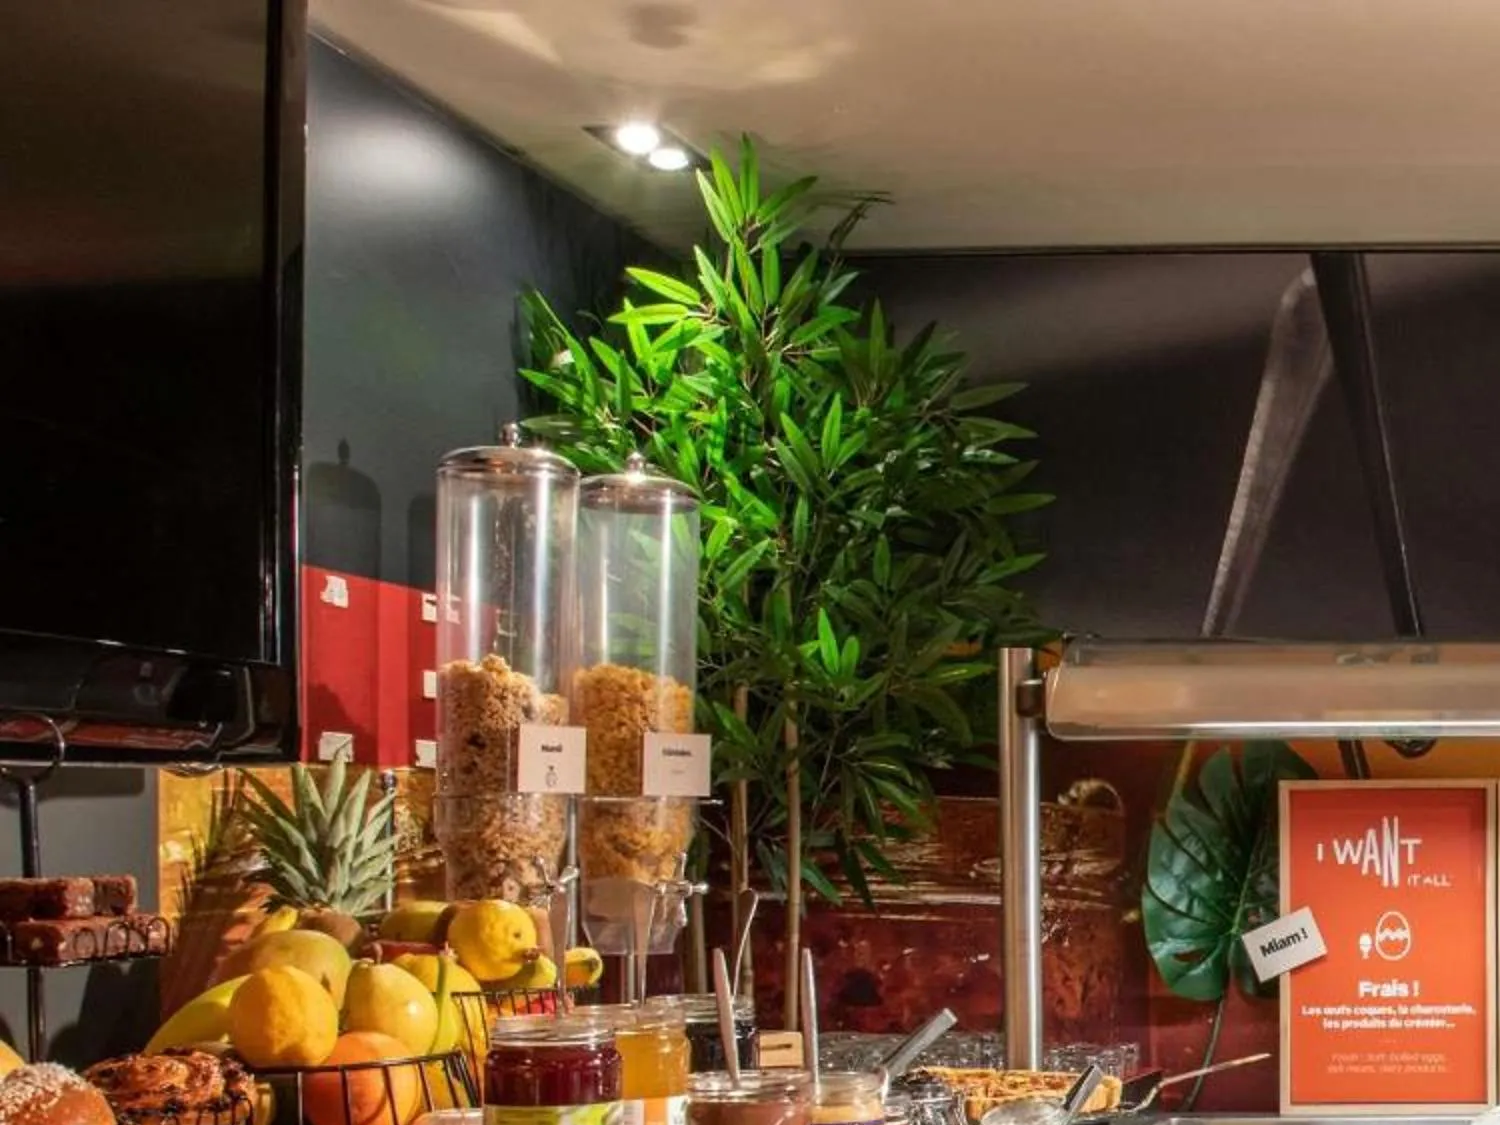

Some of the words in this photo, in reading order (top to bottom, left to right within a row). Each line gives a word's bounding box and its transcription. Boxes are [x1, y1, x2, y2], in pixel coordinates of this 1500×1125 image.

[1332, 815, 1422, 889] WANT
[1422, 874, 1451, 887] ALL
[1358, 979, 1409, 998] Frais
